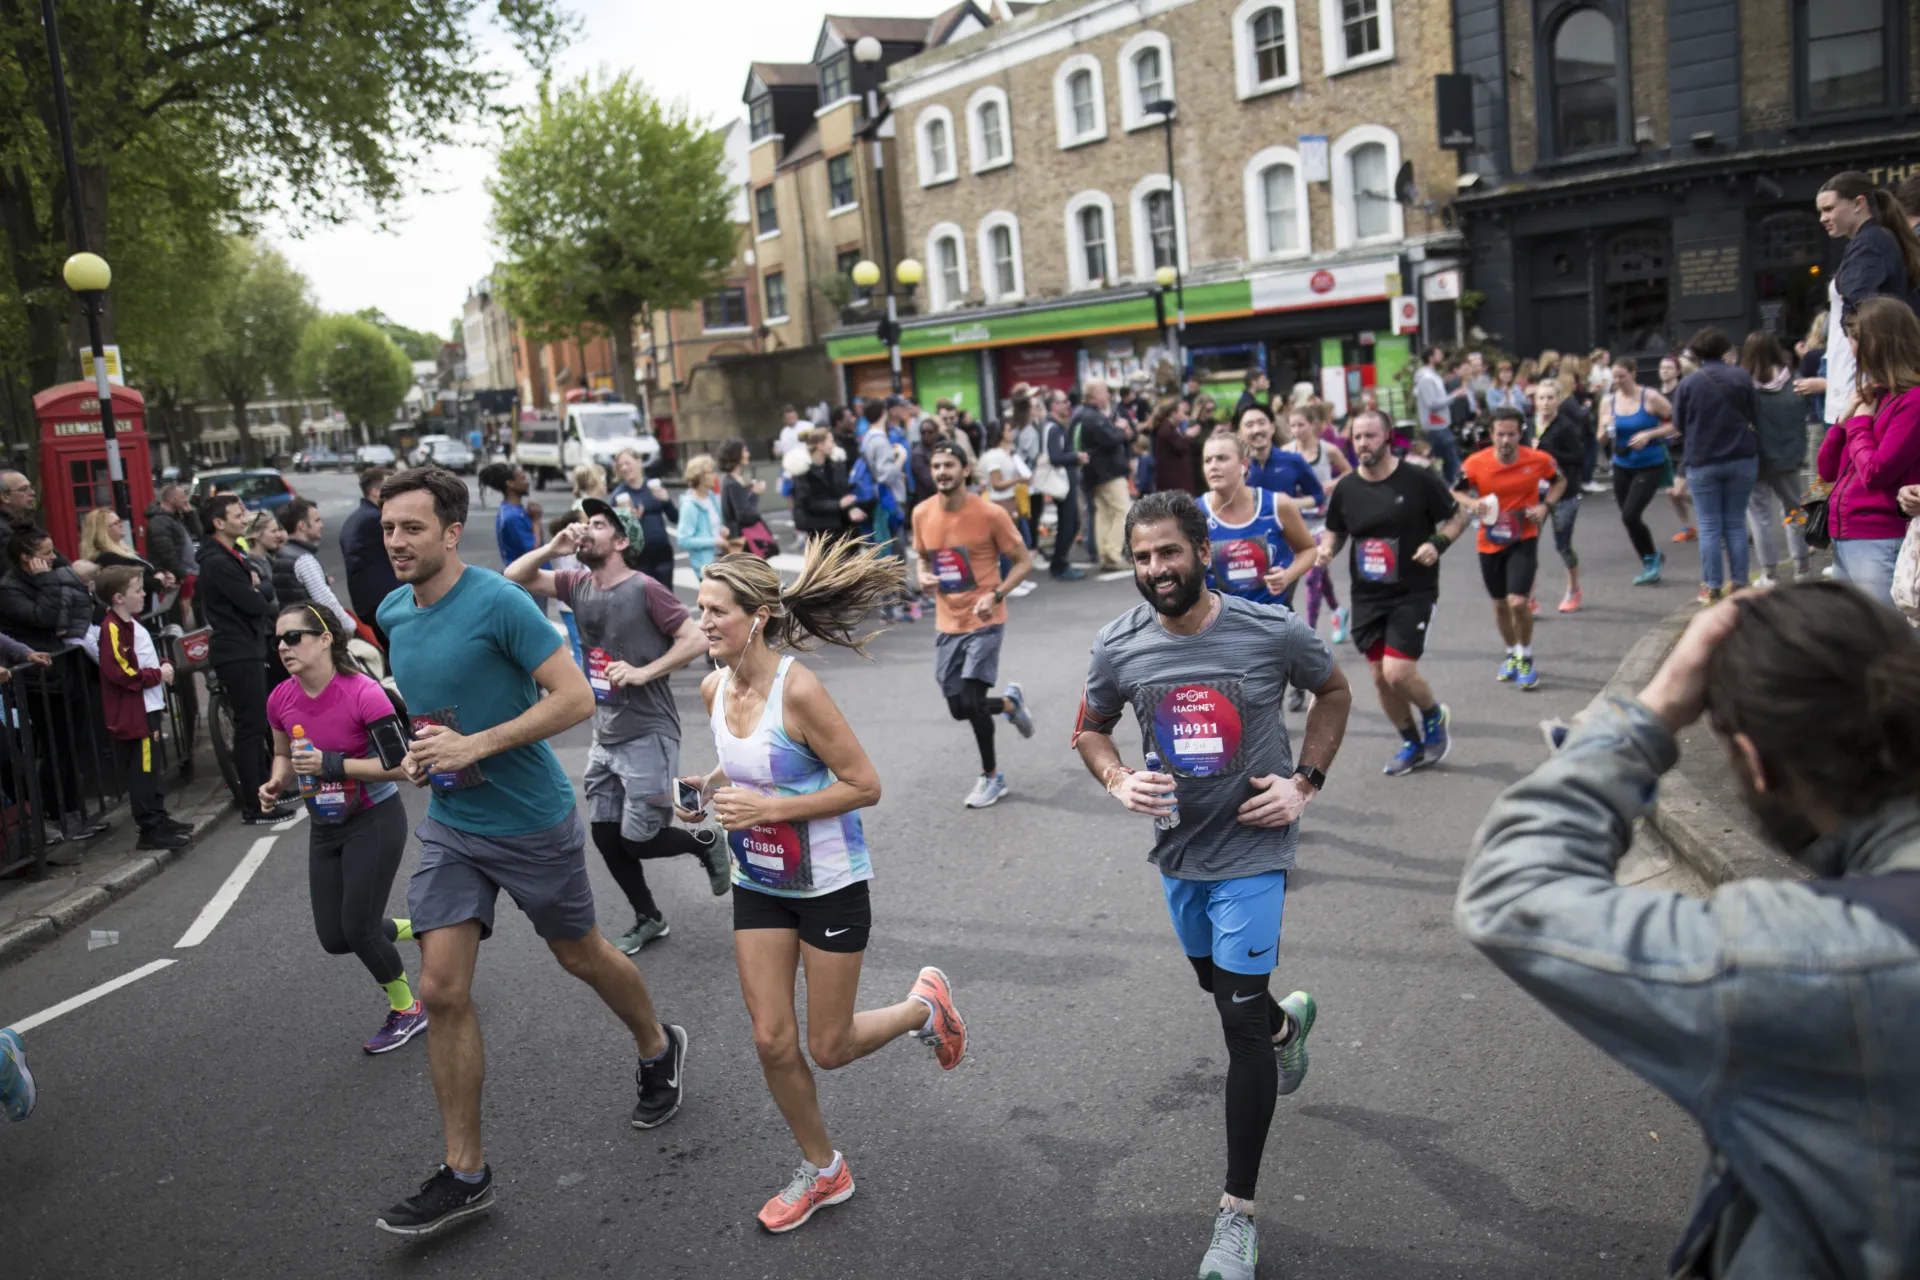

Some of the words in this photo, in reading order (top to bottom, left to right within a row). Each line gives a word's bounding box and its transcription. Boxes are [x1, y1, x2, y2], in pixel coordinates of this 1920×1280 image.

[1172, 704, 1215, 713] HACKNEY
[1173, 723, 1217, 735] H4911
[742, 837, 784, 854] G10806
